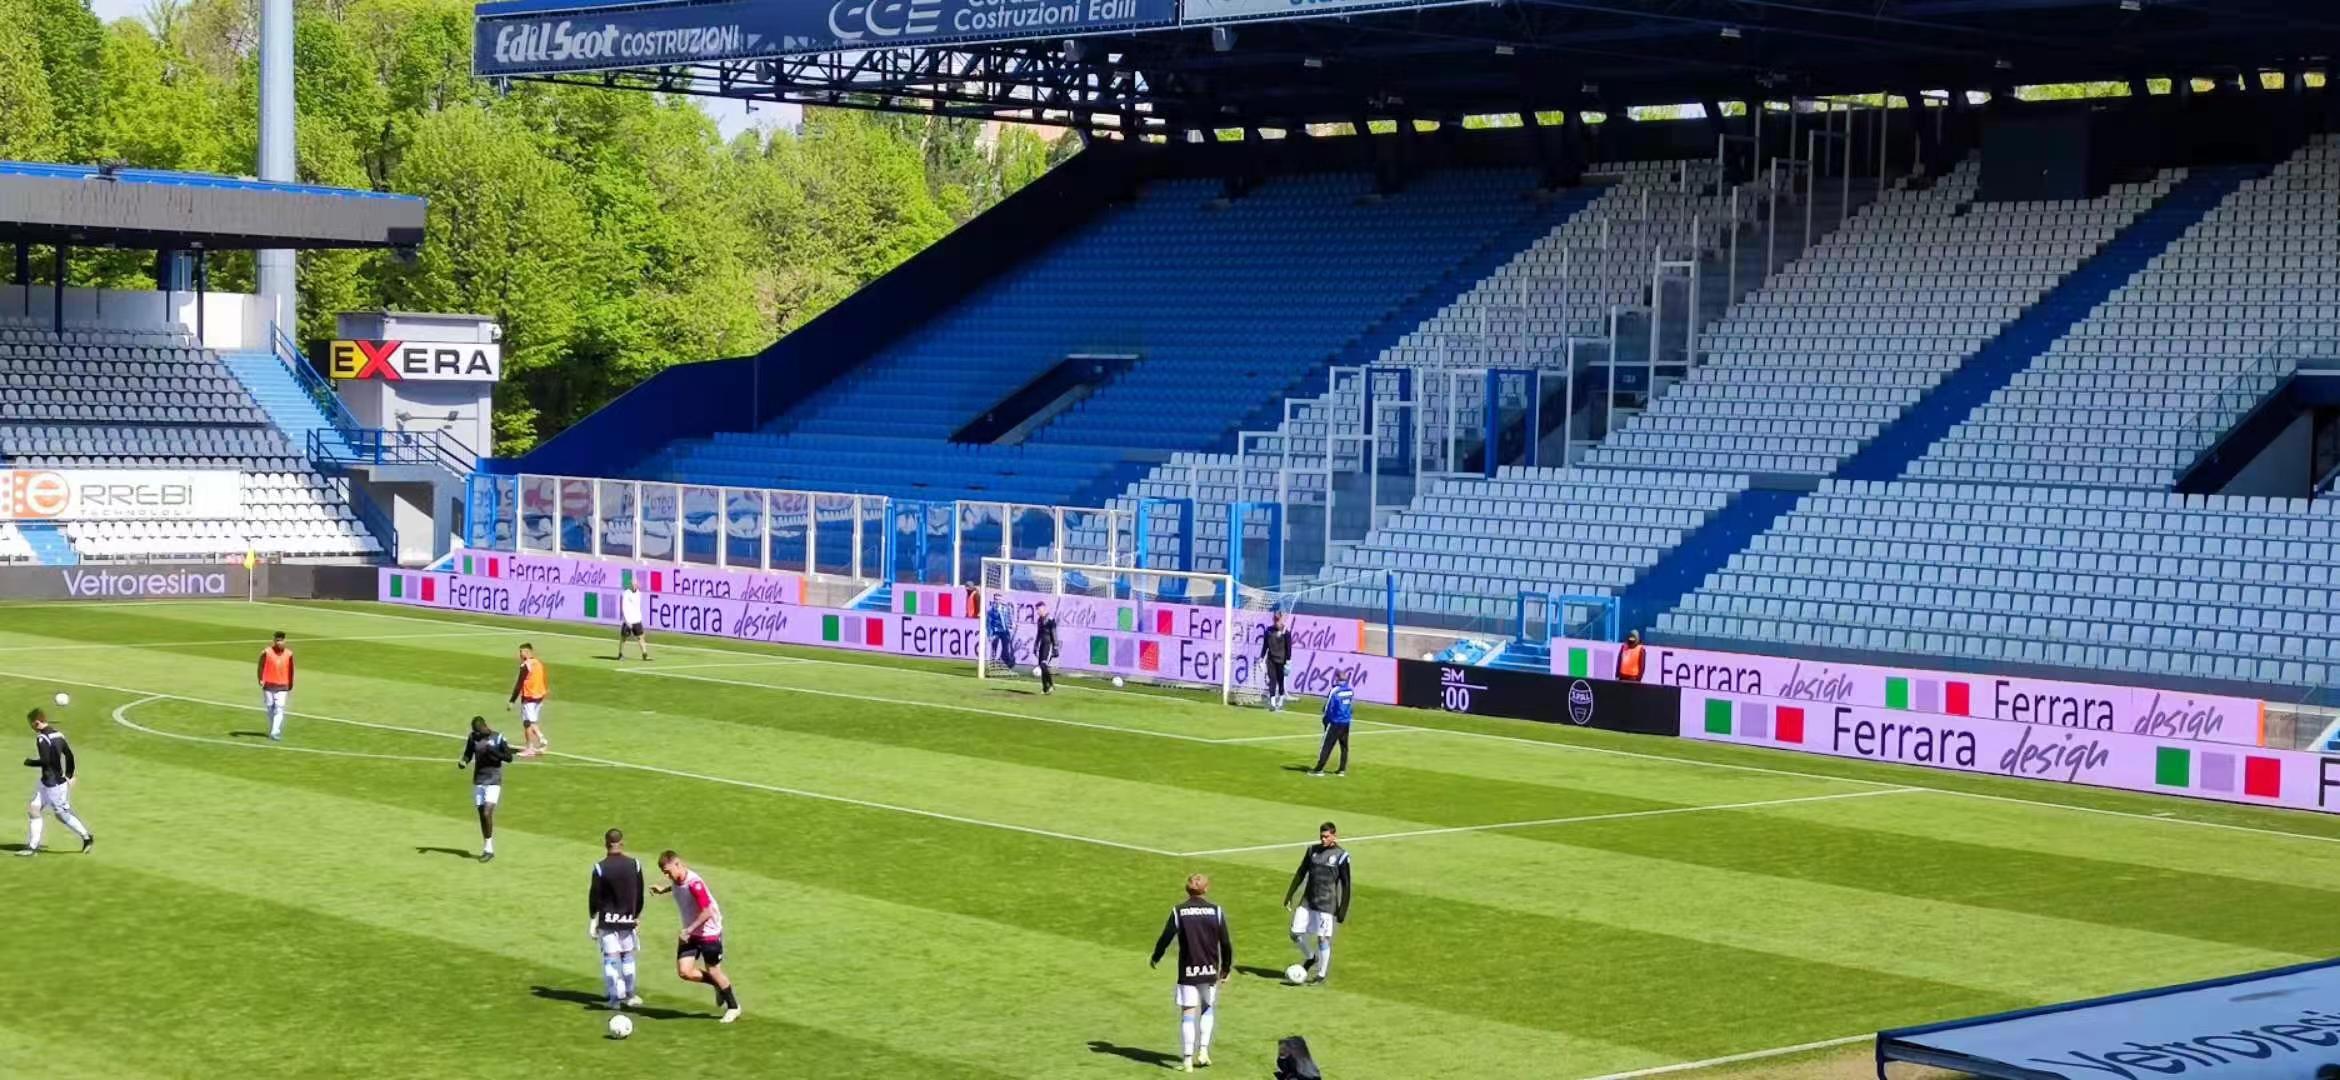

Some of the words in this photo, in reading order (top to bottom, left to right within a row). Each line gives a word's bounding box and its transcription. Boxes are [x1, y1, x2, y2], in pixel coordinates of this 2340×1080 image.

[954, 2, 1079, 31] Costruzioni
[1088, 0, 1137, 20] Edili
[620, 25, 739, 57] COSTRUZIONI
[335, 340, 493, 382] EXERA
[62, 568, 226, 596] Vetroresina
[509, 555, 560, 583] Ferrara
[673, 568, 731, 599] Ferrara
[449, 575, 510, 612] Ferrara
[518, 584, 566, 619] design
[649, 594, 722, 634] Ferrara
[733, 602, 788, 641] design
[1660, 651, 1762, 696] Ferrara
[1779, 662, 1854, 702] design
[1994, 680, 2114, 731] Ferrara
[2133, 692, 2224, 739] design
[1833, 706, 1976, 767] Ferrara
[2000, 725, 2110, 783] design
